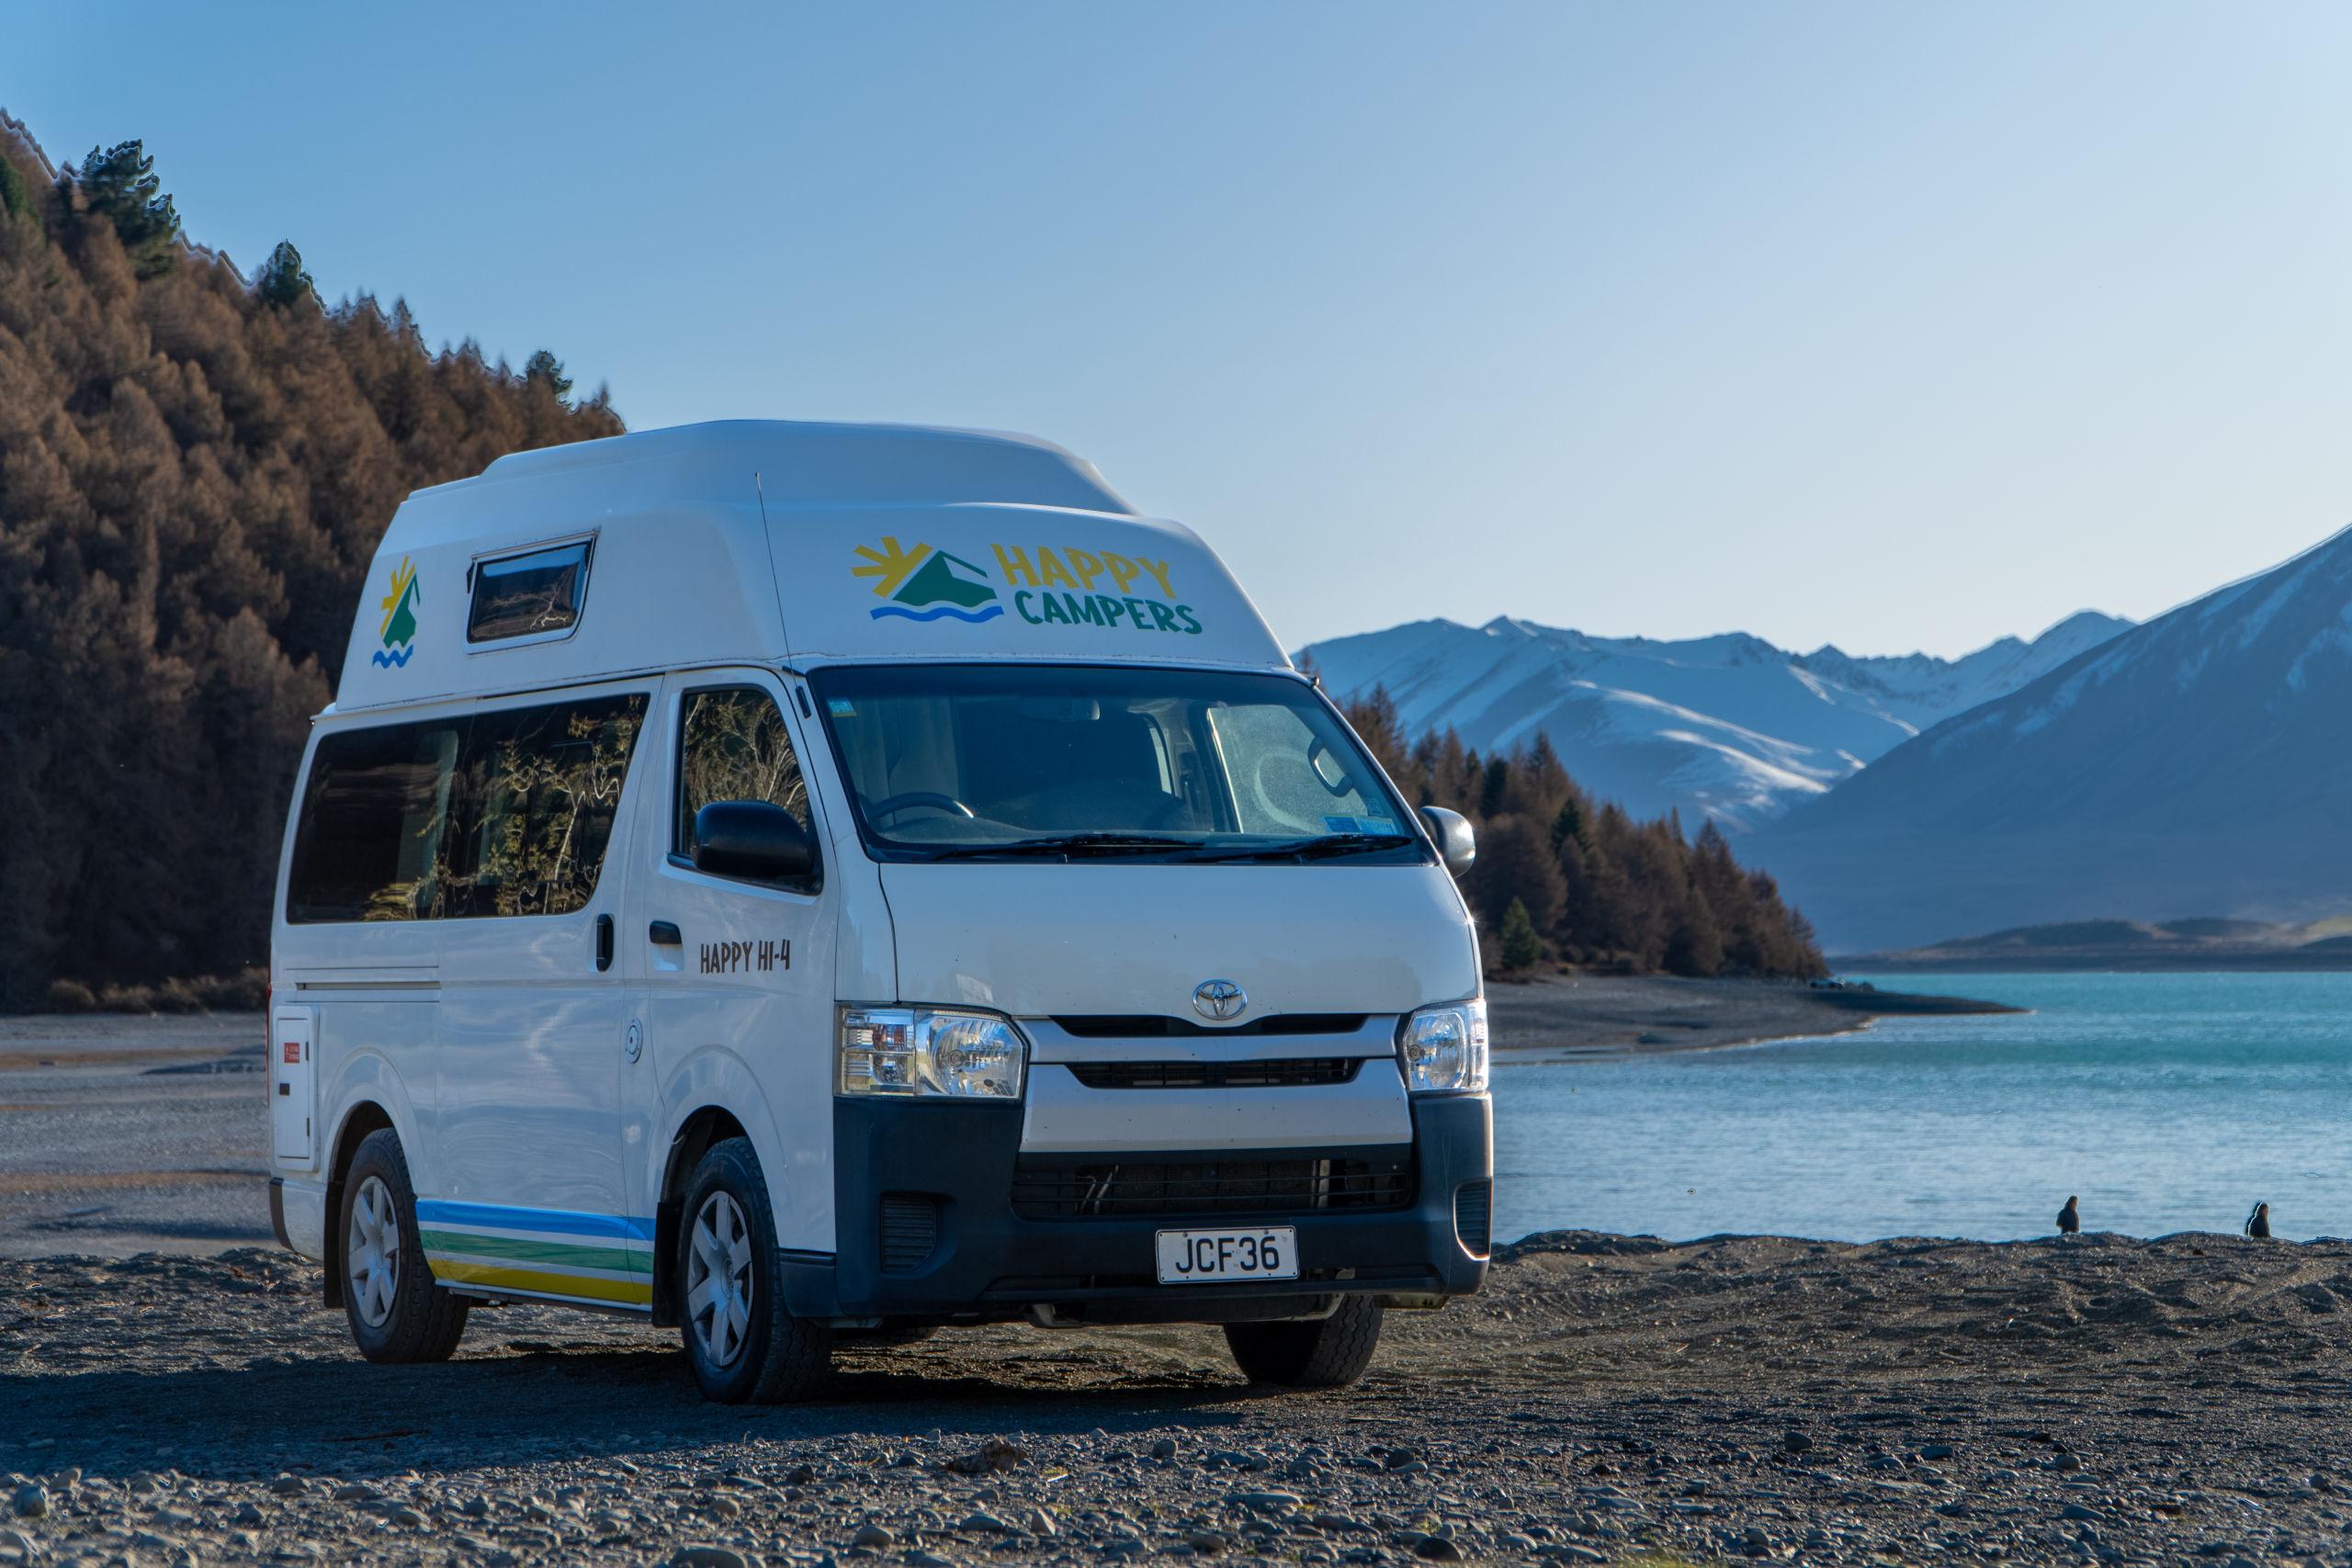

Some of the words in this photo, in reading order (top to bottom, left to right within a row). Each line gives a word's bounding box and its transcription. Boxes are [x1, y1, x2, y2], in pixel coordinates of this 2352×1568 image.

[990, 543, 1177, 600] HAPPY
[1014, 590, 1203, 635] CAMPERS
[700, 942, 753, 975] HAPPY
[758, 939, 791, 972] HI-4
[1175, 1235, 1280, 1274] JCF36
